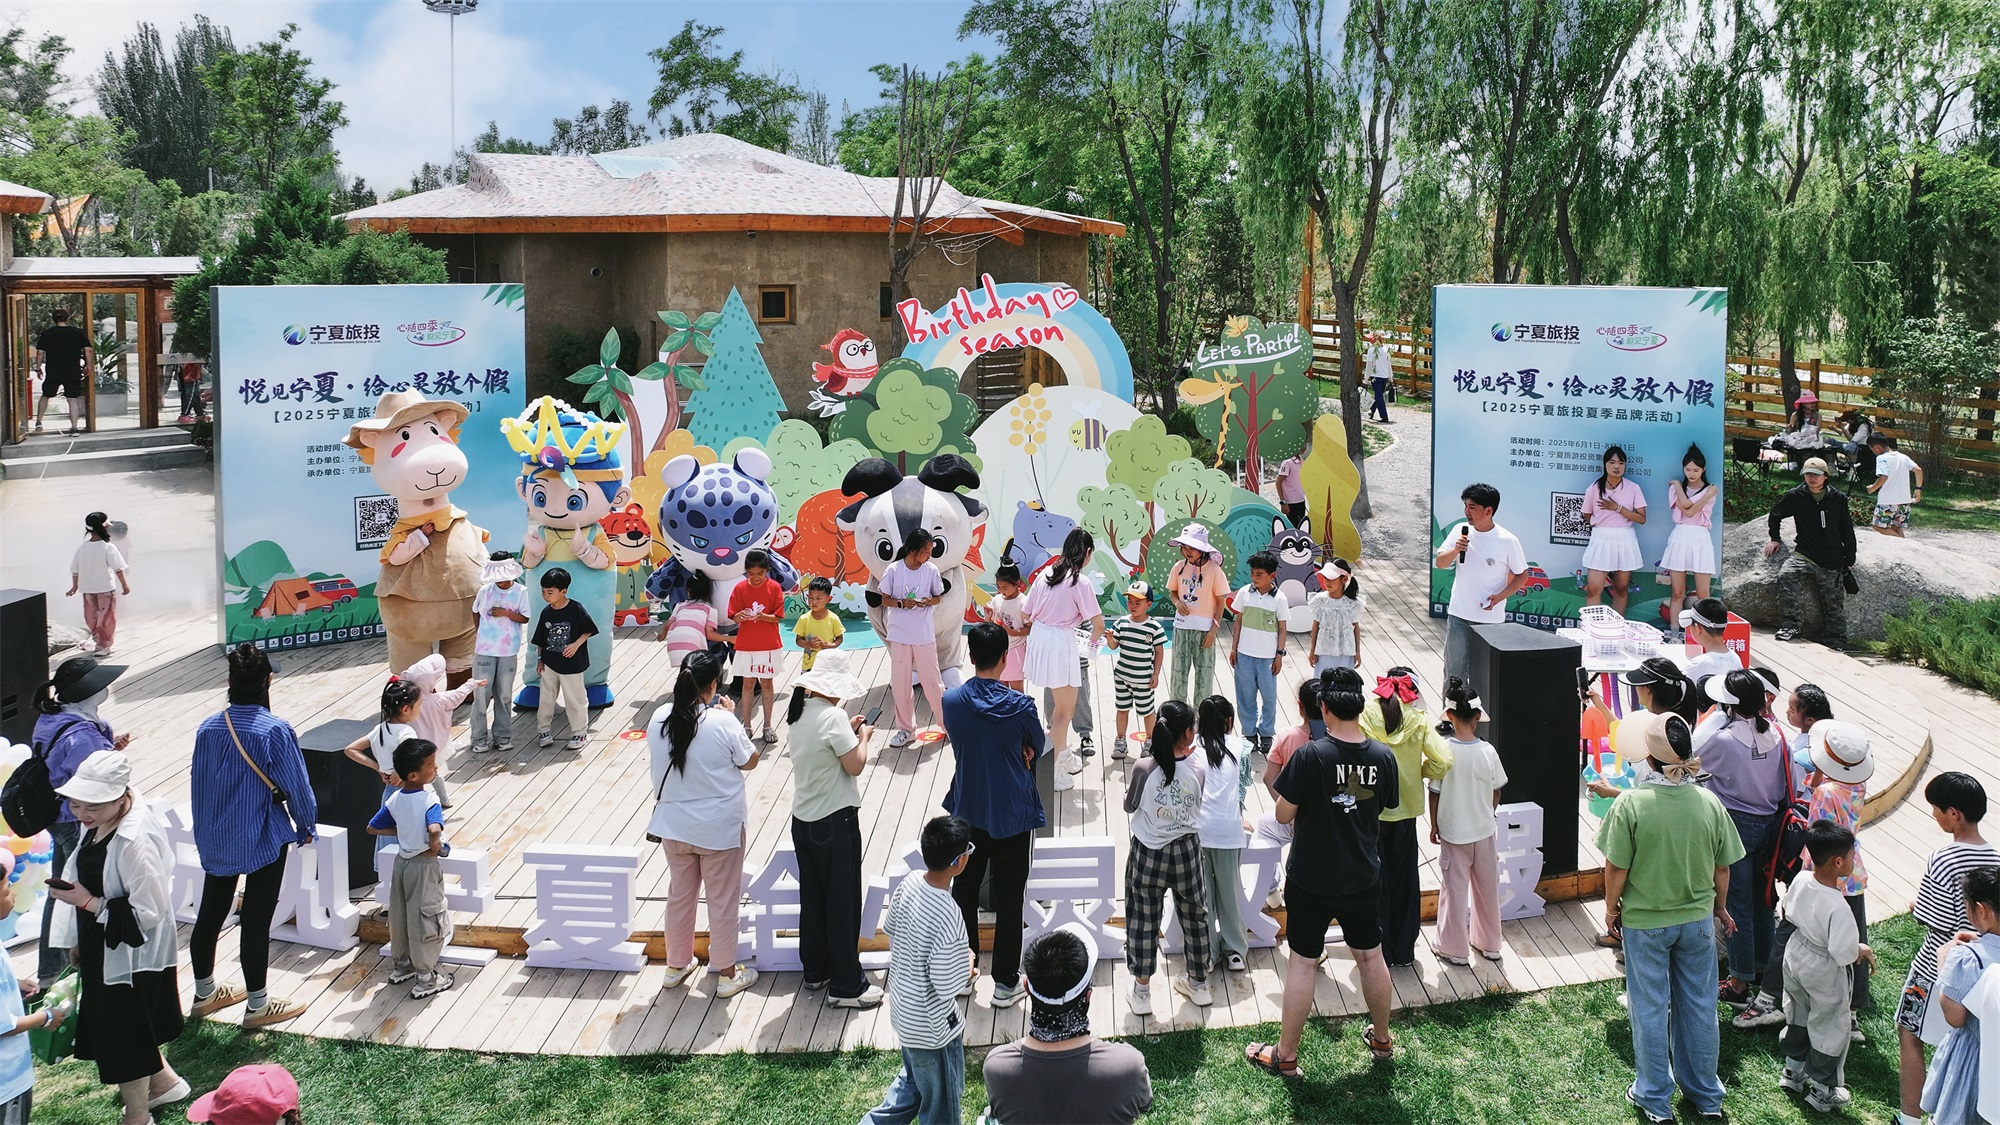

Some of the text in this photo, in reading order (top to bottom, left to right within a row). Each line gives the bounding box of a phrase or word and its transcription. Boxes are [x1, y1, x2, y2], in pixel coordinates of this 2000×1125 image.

[897, 274, 1052, 344] Birthday
[309, 323, 380, 341] 宁夏旅投
[396, 319, 438, 333] 心随四季
[1514, 323, 1581, 341] 宁夏旅投
[1595, 324, 1639, 337] 心随四季
[959, 325, 1065, 356] season
[1452, 368, 1715, 408] 悦见宁夏·给心灵放个假
[1481, 400, 1683, 424] 【2025宁夏旅投夏季品牌活动】
[1335, 764, 1378, 785] NIKE
